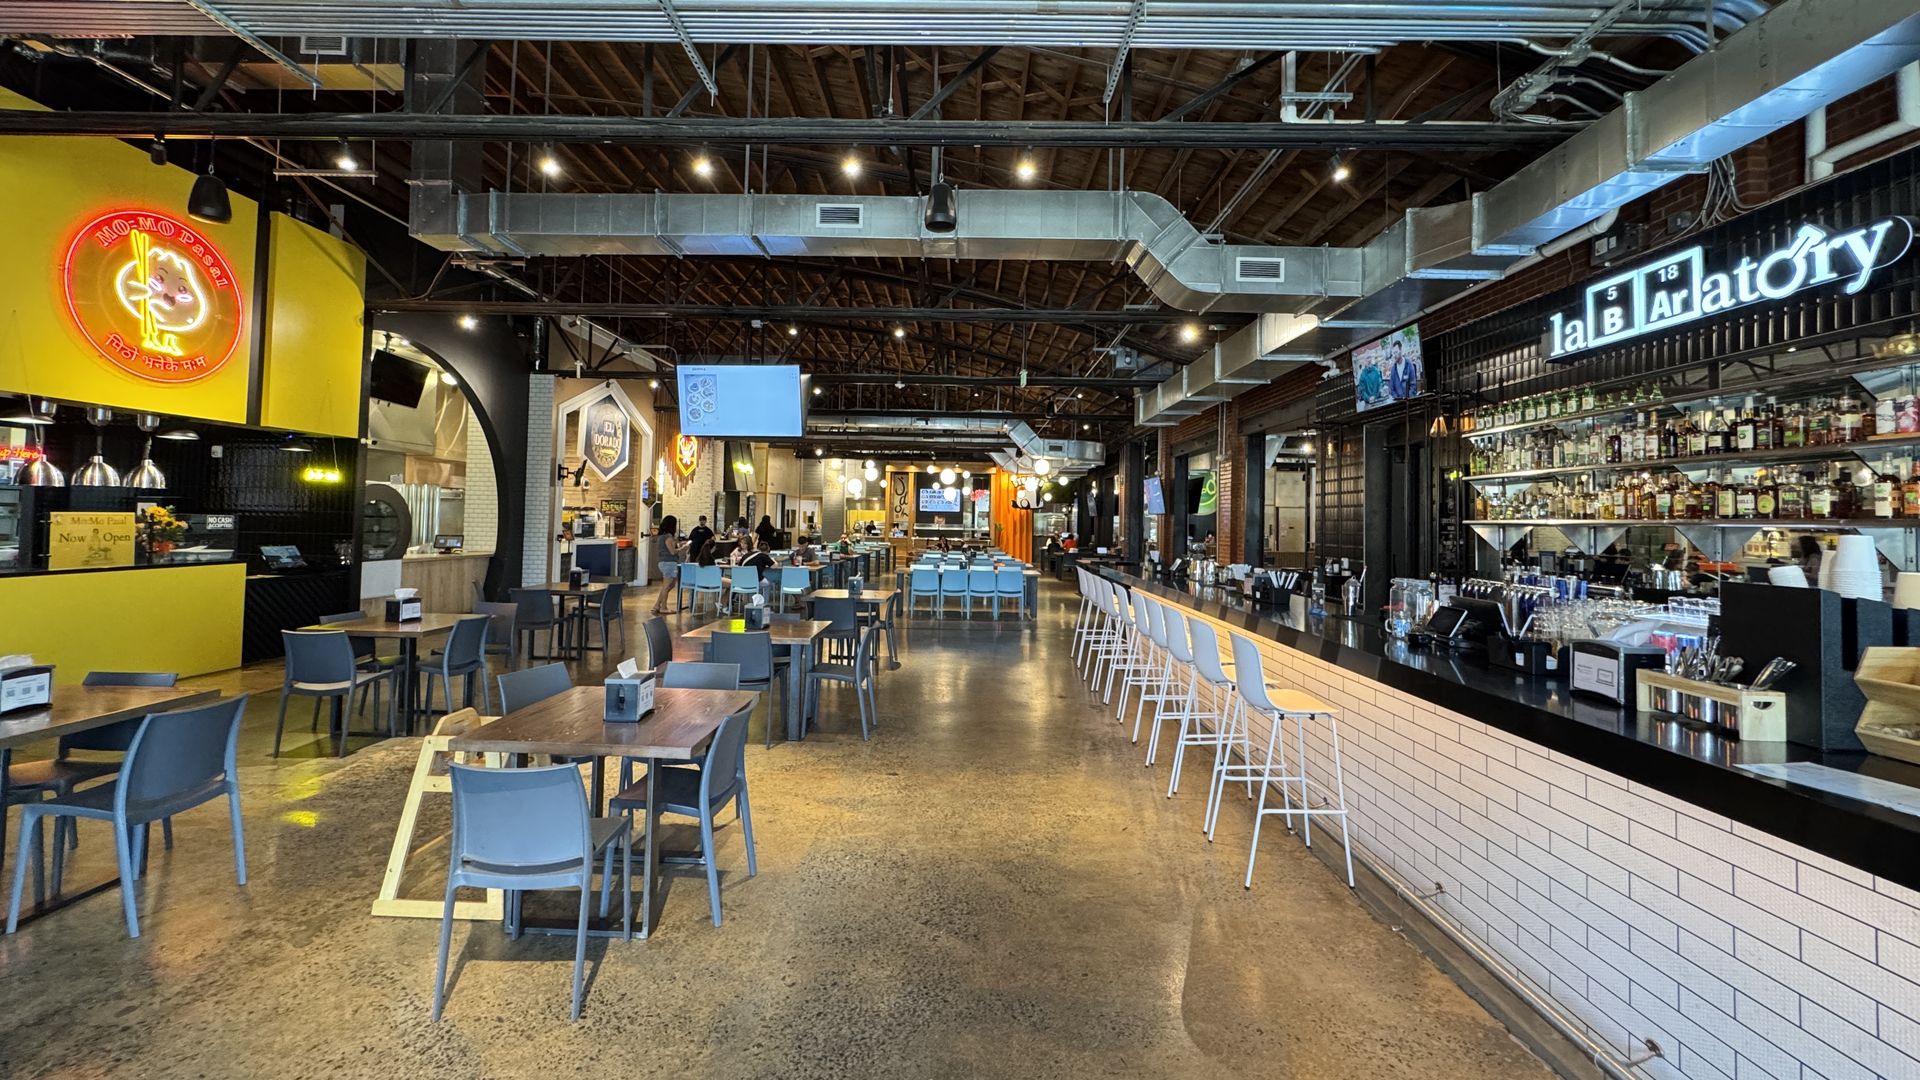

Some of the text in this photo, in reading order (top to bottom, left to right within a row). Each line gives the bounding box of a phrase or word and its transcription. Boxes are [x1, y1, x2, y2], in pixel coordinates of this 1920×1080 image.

[1657, 264, 1679, 283] 18
[1606, 287, 1618, 301] 5
[595, 434, 620, 448] DORADO
[58, 532, 131, 544] Now Open
